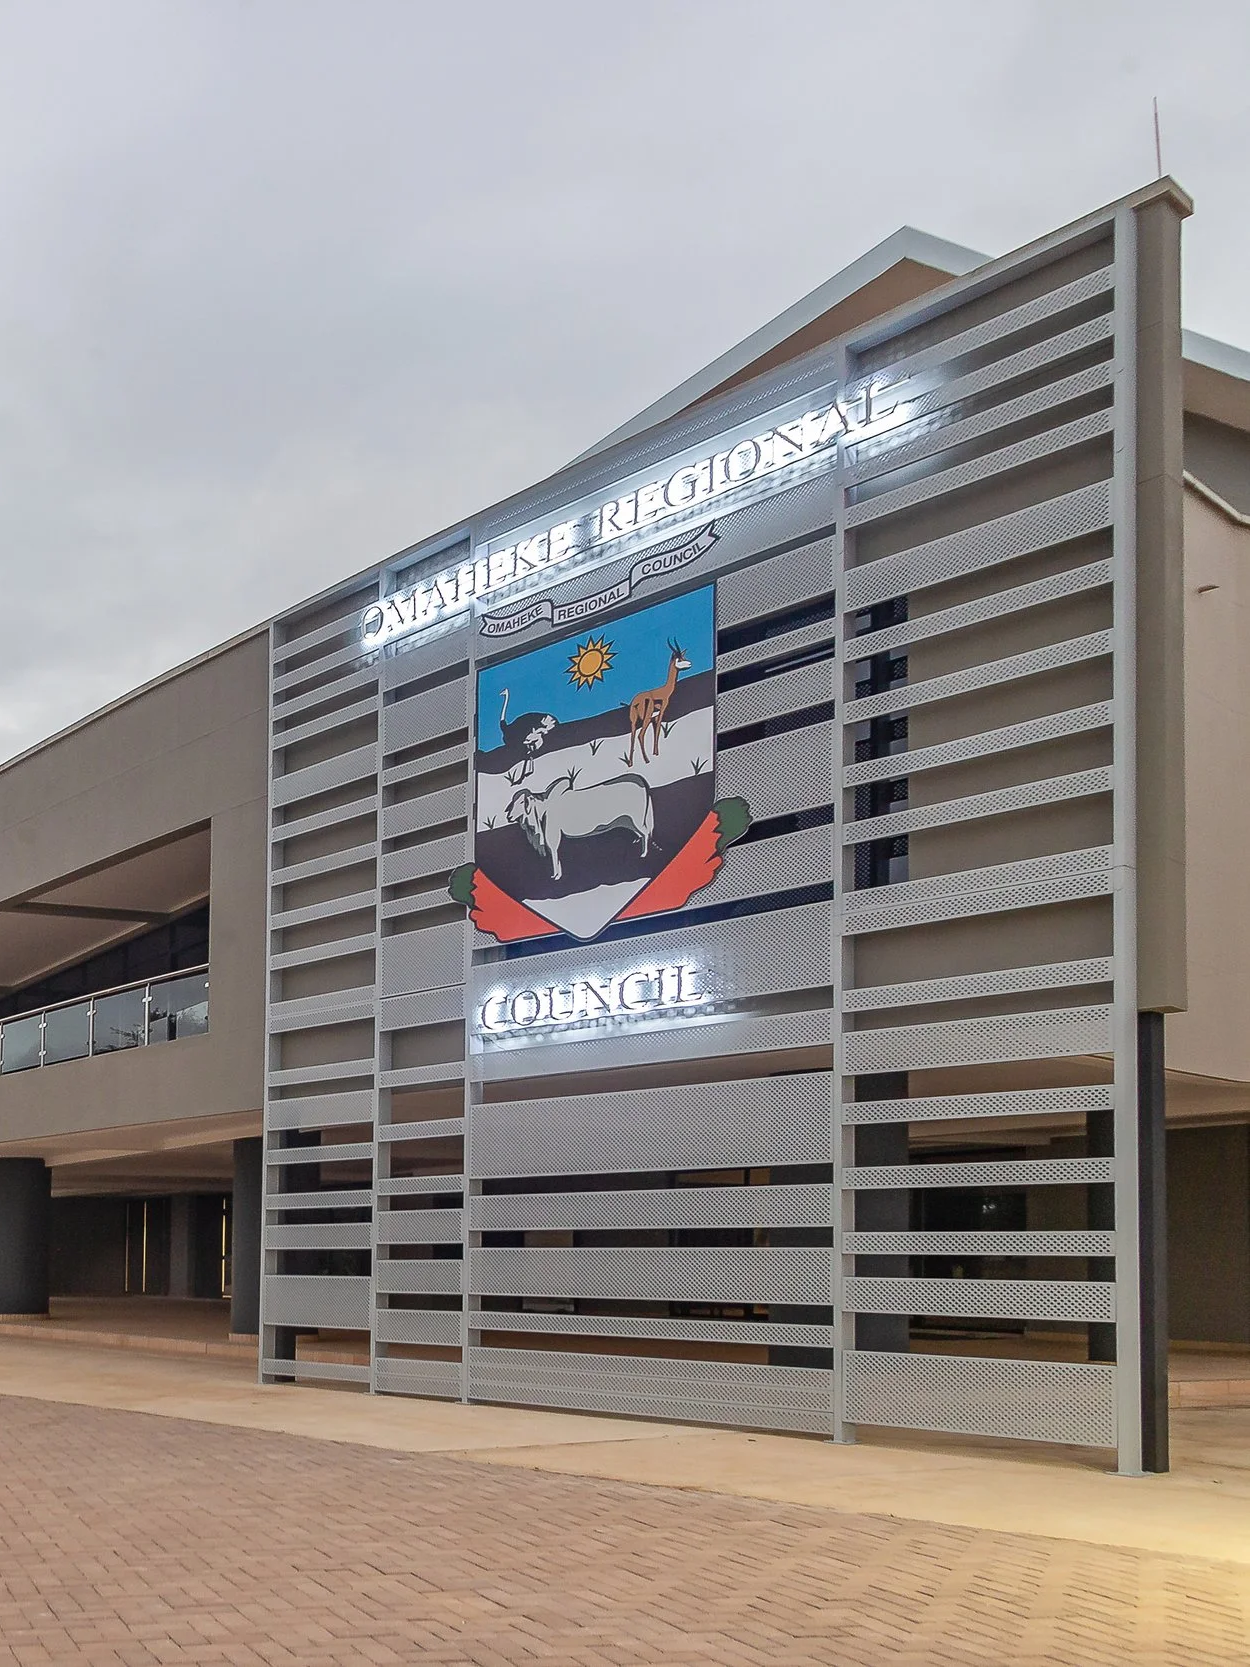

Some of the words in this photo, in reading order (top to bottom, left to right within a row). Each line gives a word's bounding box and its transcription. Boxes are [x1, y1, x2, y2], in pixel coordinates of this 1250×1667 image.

[361, 519, 580, 640] OMAHEKE
[595, 380, 900, 539] REGIONAL
[487, 604, 544, 634] OMAHEKE
[557, 587, 625, 621] REGIONAL
[641, 541, 708, 576] COUNCIL
[480, 965, 705, 1030] COUNCIL
